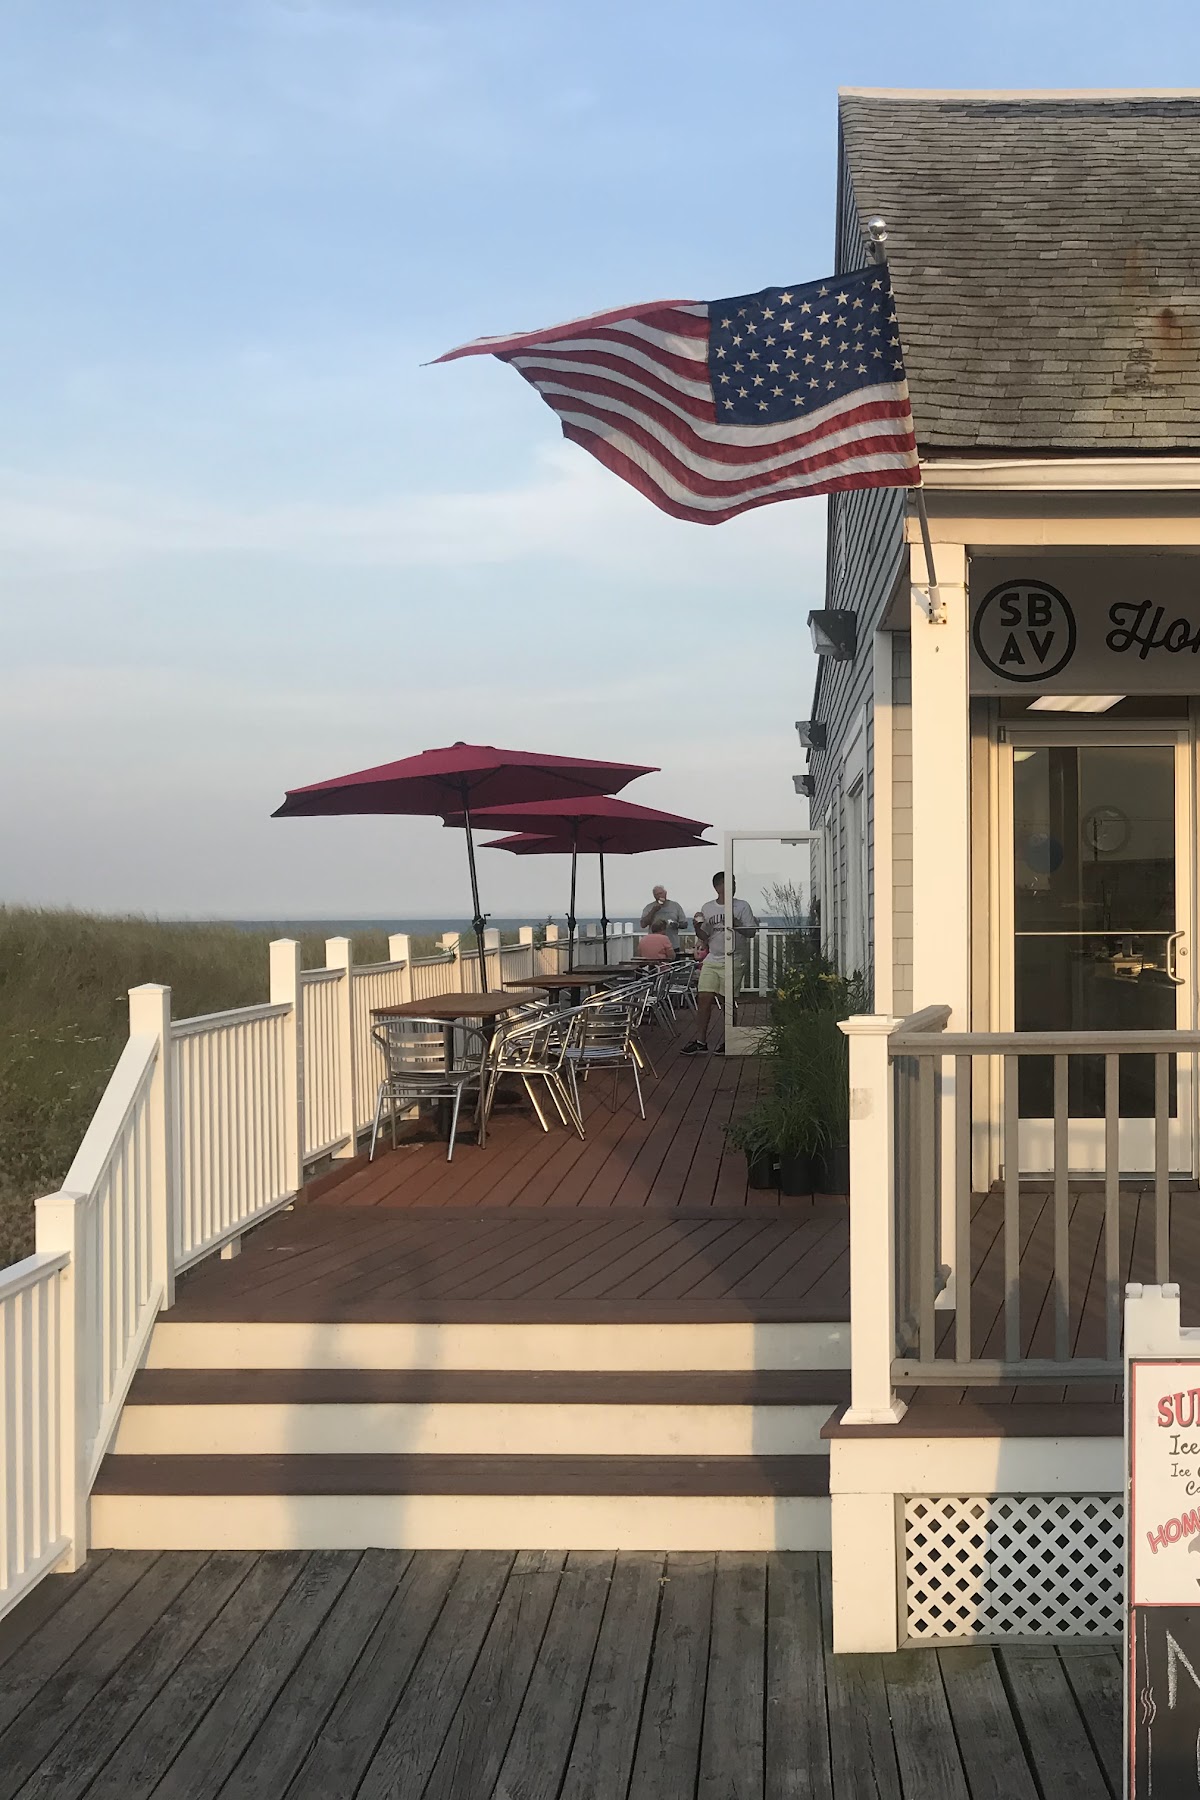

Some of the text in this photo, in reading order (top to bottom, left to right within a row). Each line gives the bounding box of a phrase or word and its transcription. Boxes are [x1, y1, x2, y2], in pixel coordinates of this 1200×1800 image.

[1000, 593, 1053, 627] SB
[999, 631, 1055, 665] AV
[1169, 1434, 1200, 1456] Ice
[1170, 1463, 1191, 1477] Ice
